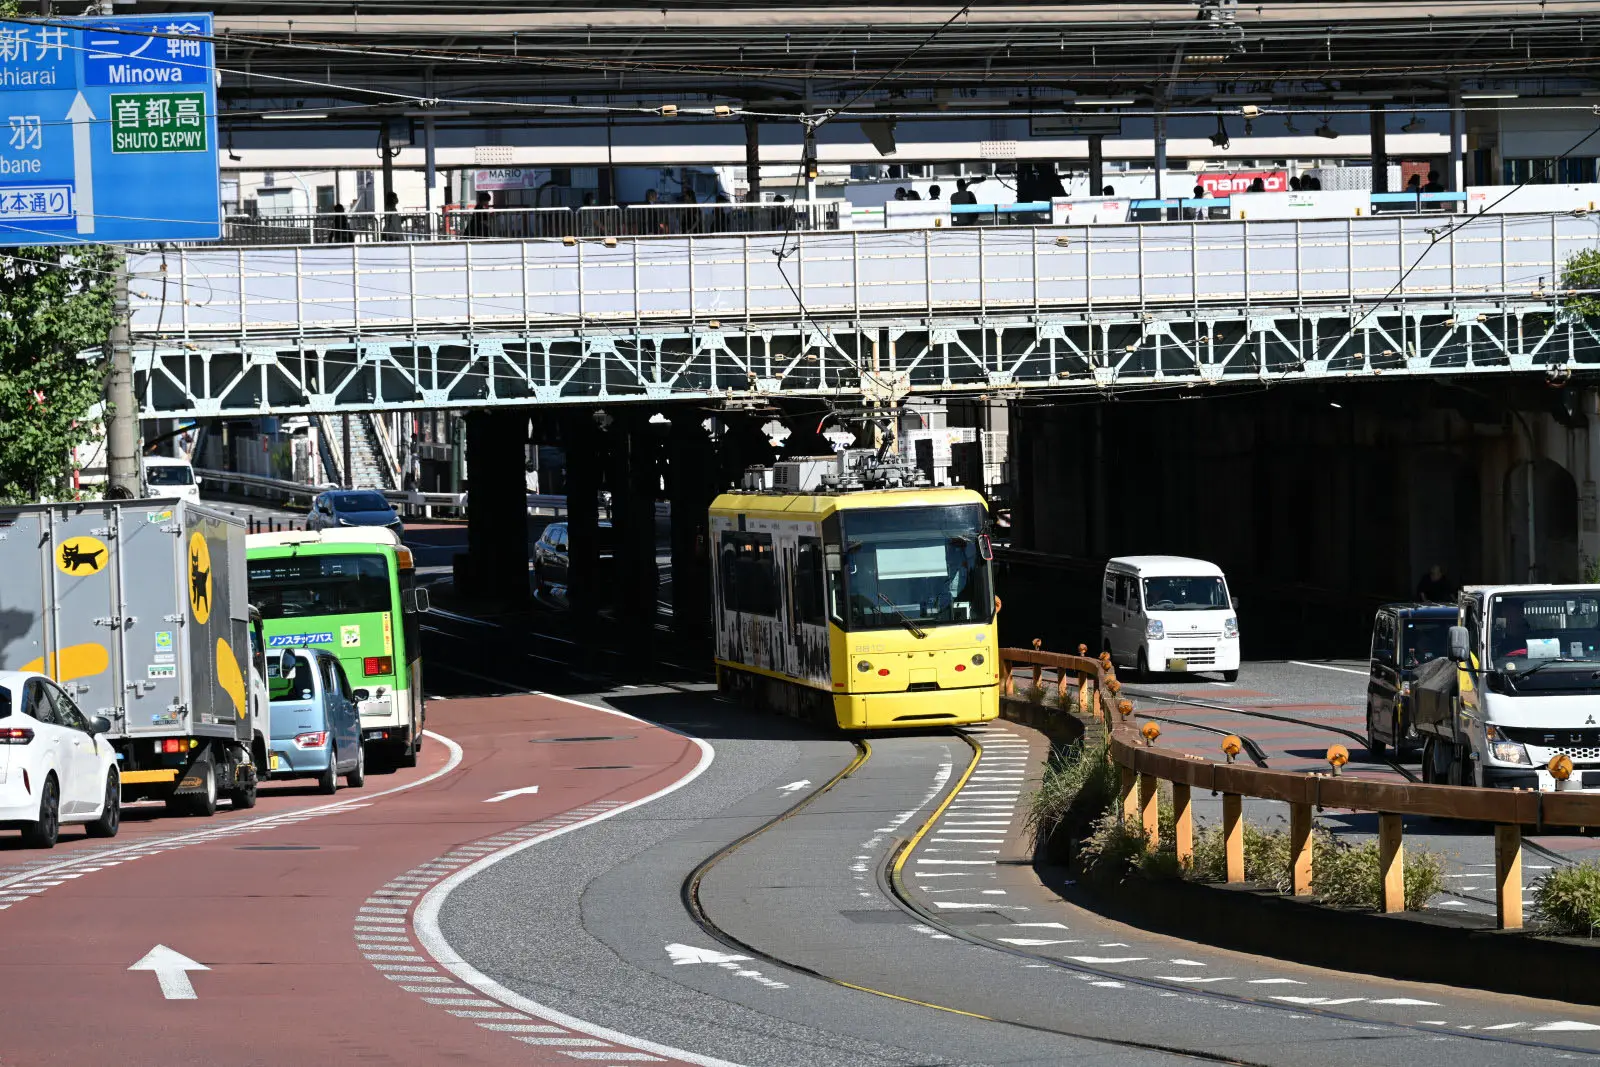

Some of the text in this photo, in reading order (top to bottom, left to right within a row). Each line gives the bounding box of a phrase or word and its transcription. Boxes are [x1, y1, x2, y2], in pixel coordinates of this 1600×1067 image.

[0, 26, 68, 62] 新井
[89, 23, 201, 58] 三ノ輪
[109, 64, 182, 83] Minowa
[116, 98, 200, 129] 首都高
[9, 115, 42, 149] 羽
[116, 131, 201, 149] SHUTO EXPWY
[0, 154, 41, 174] bane
[489, 169, 522, 179] MARIO
[270, 633, 333, 646] ノンステップバス
